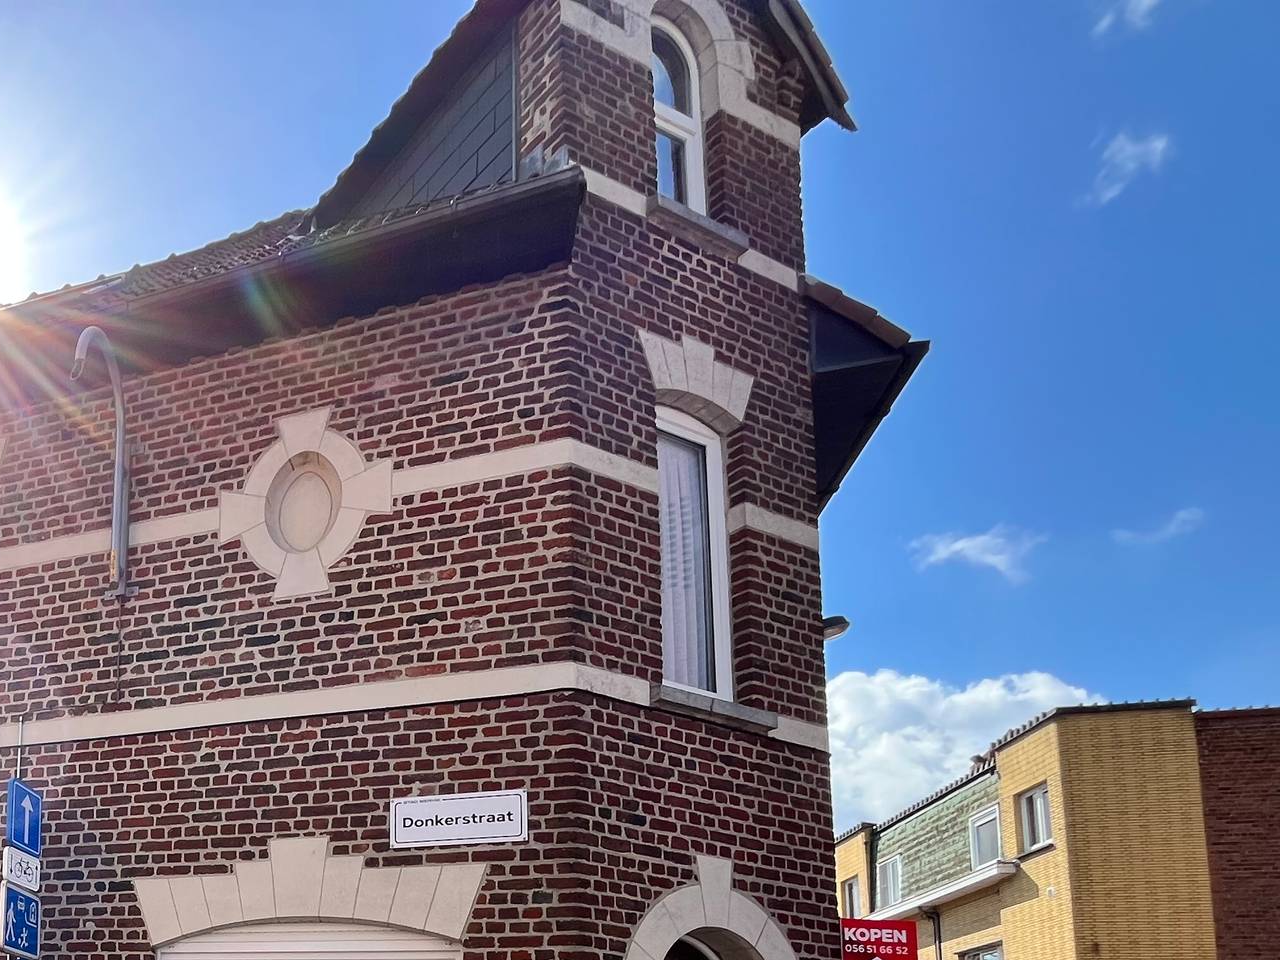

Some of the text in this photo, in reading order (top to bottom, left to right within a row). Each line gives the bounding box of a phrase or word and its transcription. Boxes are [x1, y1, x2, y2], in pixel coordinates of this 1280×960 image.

[402, 811, 514, 828] Donkerstraat
[844, 927, 907, 943] KOPEN
[845, 944, 908, 955] 056 51 66 52
